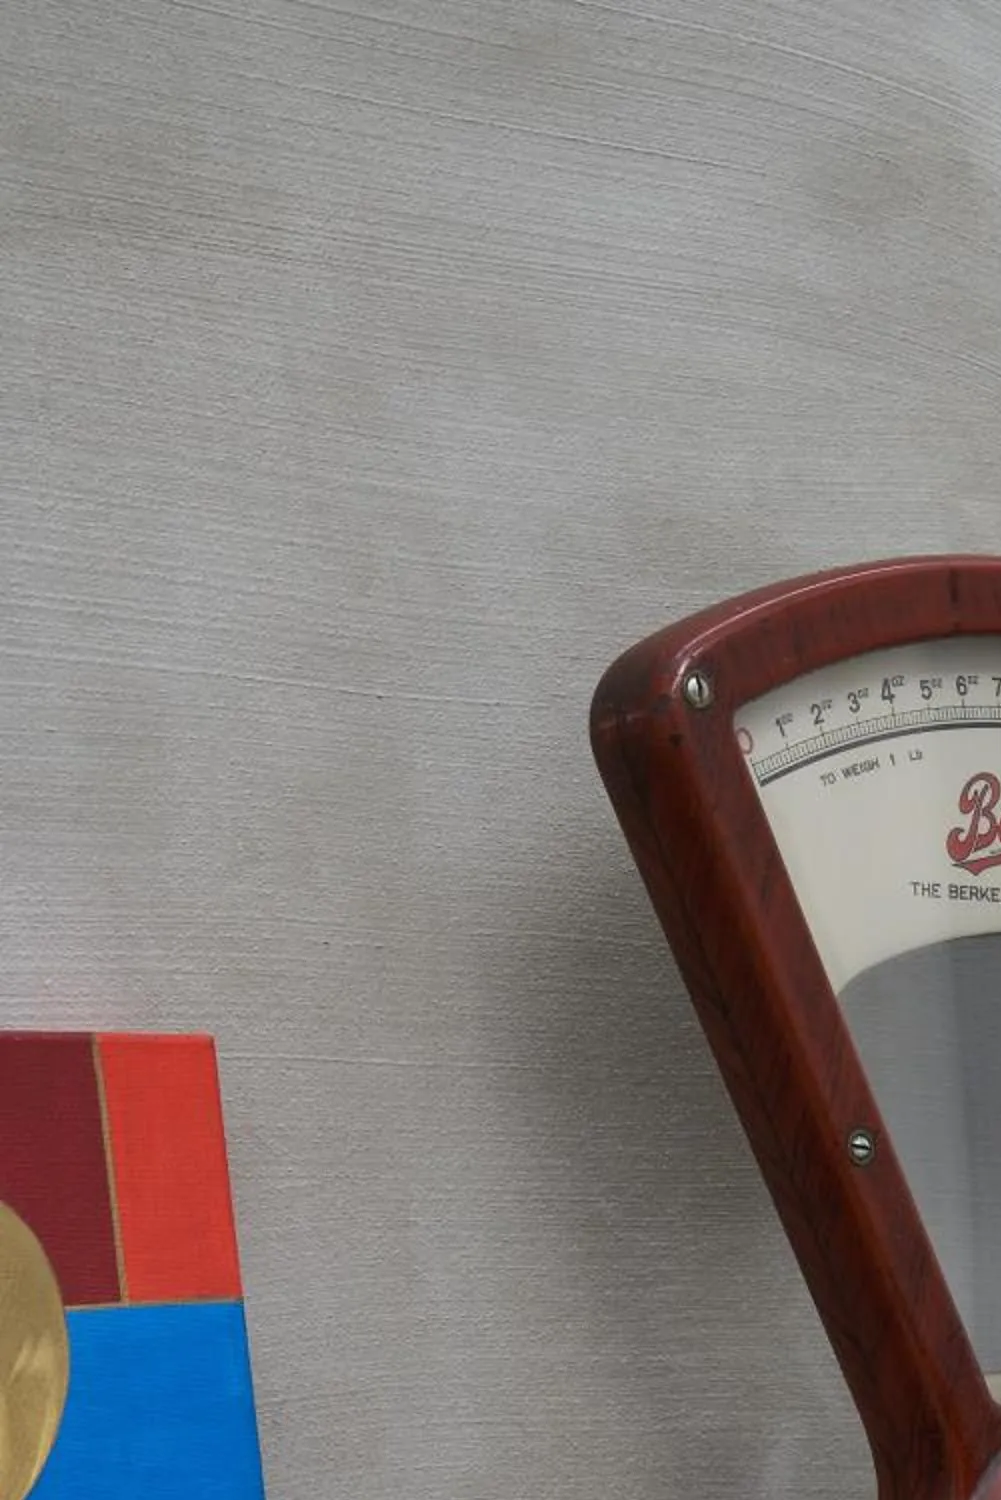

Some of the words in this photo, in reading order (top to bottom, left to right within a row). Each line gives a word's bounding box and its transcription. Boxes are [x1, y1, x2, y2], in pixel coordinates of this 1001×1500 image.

[820, 771, 837, 786] TO
[841, 756, 880, 779] WEIGH
[888, 752, 896, 766] 1
[911, 881, 942, 899] THE
